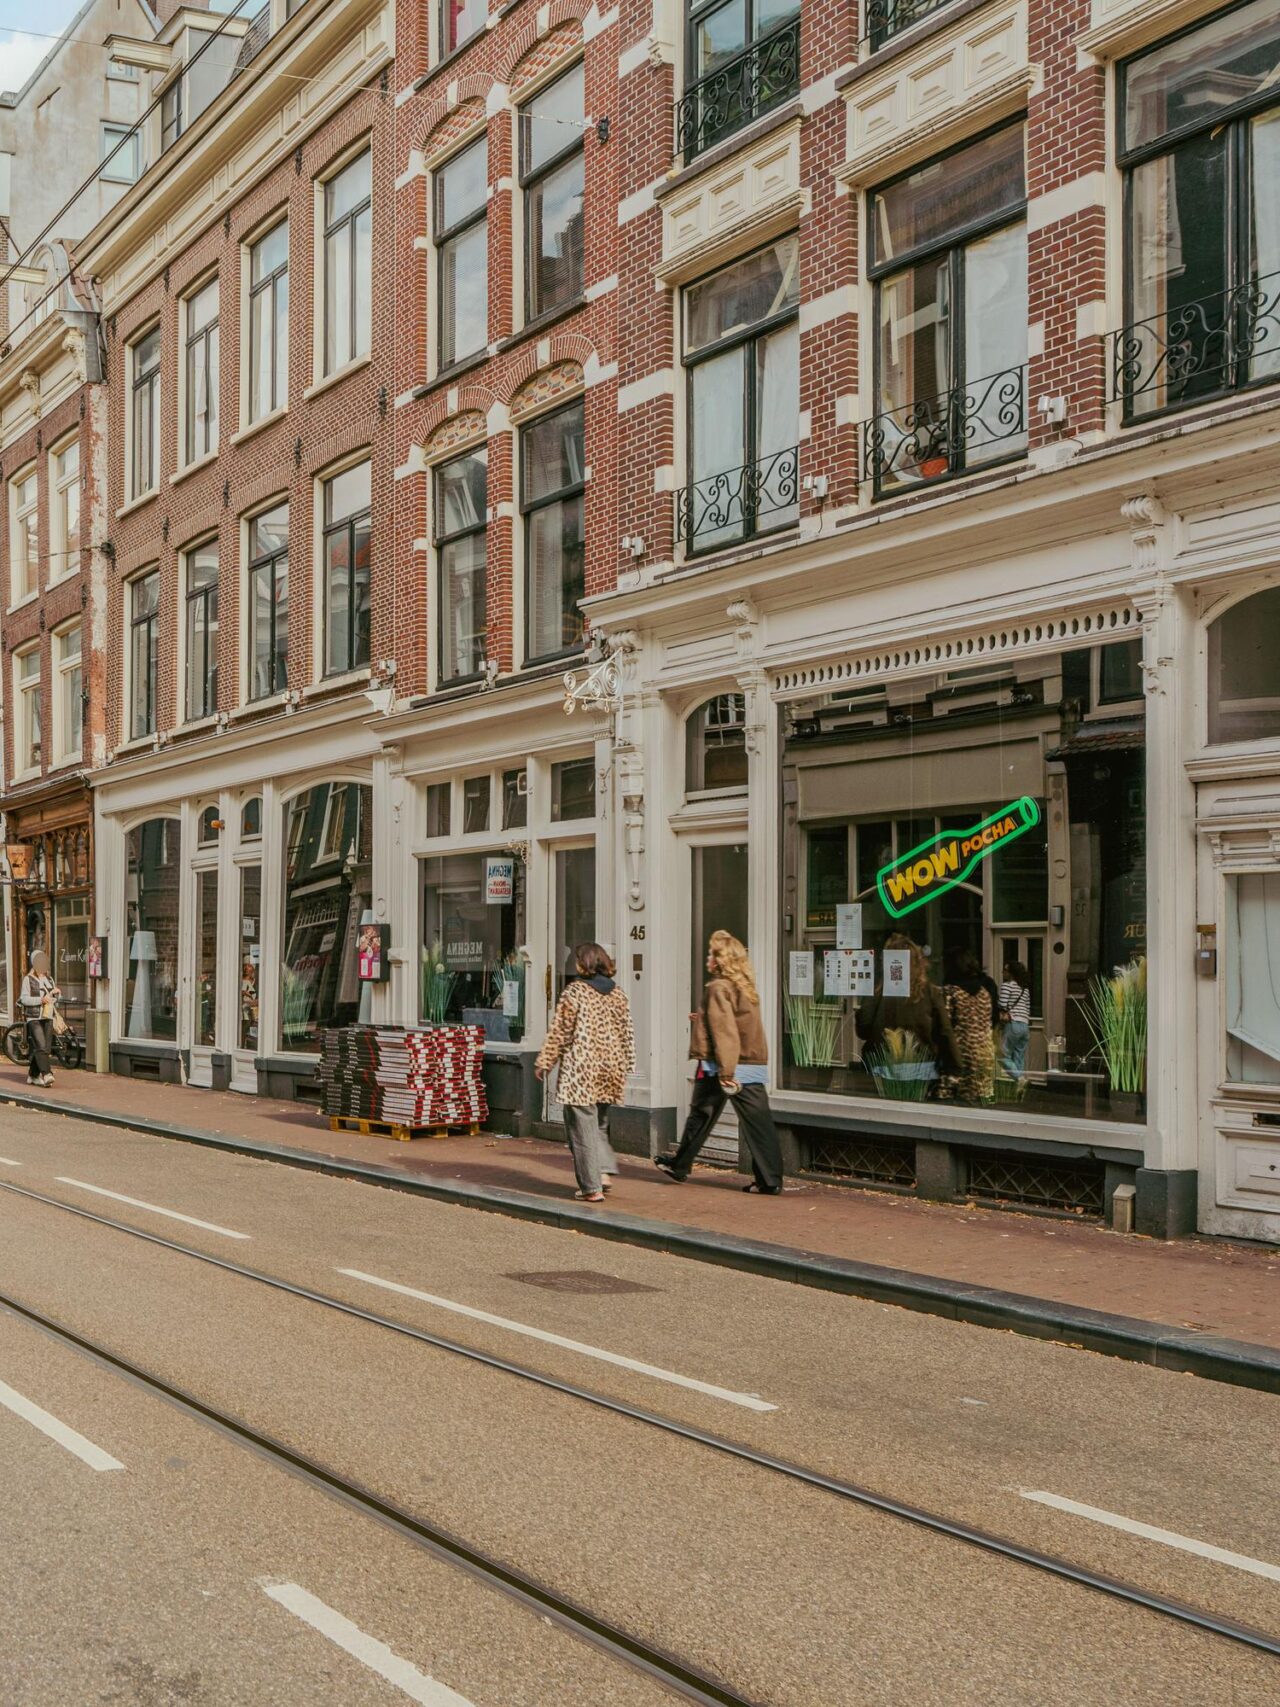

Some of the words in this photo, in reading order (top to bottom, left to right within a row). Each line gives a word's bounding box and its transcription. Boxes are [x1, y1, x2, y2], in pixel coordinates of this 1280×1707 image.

[887, 840, 959, 903] WOW
[961, 817, 1016, 857] POCHA
[630, 925, 645, 940] 45
